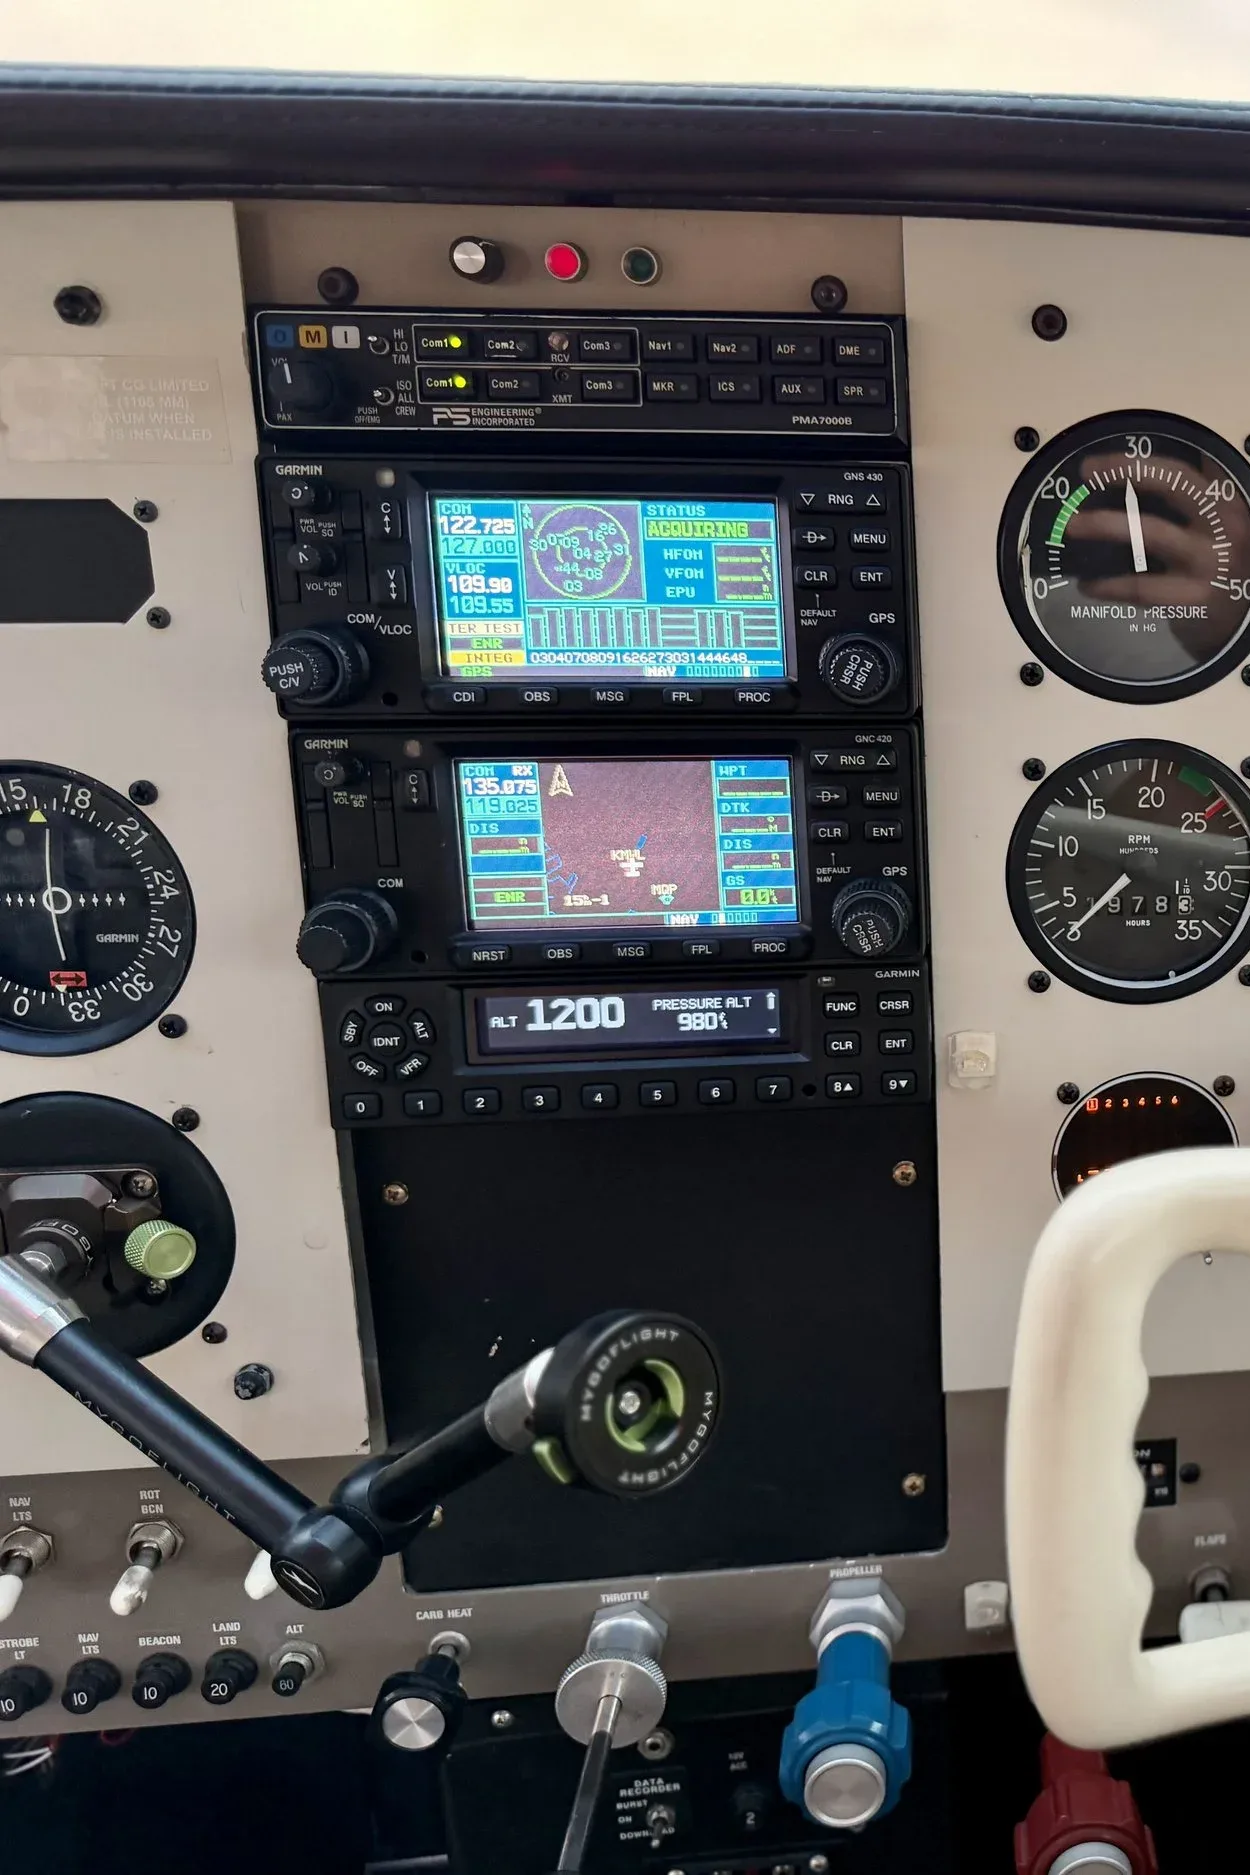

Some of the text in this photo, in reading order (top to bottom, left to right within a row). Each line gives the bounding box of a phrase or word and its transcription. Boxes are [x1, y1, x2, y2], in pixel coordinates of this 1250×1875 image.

[393, 329, 404, 340] HI
[394, 342, 408, 352] LO
[421, 337, 449, 348] Com1
[487, 340, 516, 351] Com2
[583, 340, 611, 351] Com3
[648, 340, 672, 351] Nav1
[713, 342, 737, 353] Nav2
[776, 344, 796, 355] ADF
[839, 346, 860, 357] DME
[396, 381, 412, 391] ISO
[426, 378, 454, 389] Com1
[491, 378, 519, 390] Com2
[652, 382, 675, 392] MKR
[717, 382, 735, 393] ICS
[781, 384, 802, 395] AUX
[843, 386, 864, 397] SPR
[398, 392, 415, 403] ALL
[472, 417, 535, 426] INCORPORATED
[792, 415, 853, 426] PMA7000B
[1125, 436, 1152, 459] 30
[275, 465, 323, 475] GARMIN
[844, 473, 883, 482] GNS 430
[1040, 477, 1070, 499] 20
[1205, 479, 1235, 501] 40
[828, 495, 854, 505] RNG
[441, 504, 472, 516] COM
[647, 505, 706, 517] STATUS
[440, 517, 516, 536] 122.725
[648, 521, 749, 539] ACQUIRING
[853, 534, 886, 544] MENU
[442, 537, 517, 555] 127.000
[664, 548, 703, 561] HFOM
[446, 563, 486, 575] VLOC
[665, 568, 705, 580] VFOM
[804, 571, 828, 582] CLR
[860, 572, 883, 582] ENT
[448, 576, 513, 594] 109.90
[667, 586, 696, 599] EPU
[450, 596, 515, 614] 109.55
[869, 612, 896, 624] GPS
[1071, 606, 1137, 619] MANIFOLD
[450, 623, 521, 635] TER TEST
[472, 637, 503, 650] ENR
[269, 662, 304, 676] PUSH
[279, 677, 300, 689] C/V
[453, 691, 475, 702] CDI
[524, 691, 550, 702] OBS
[596, 691, 624, 702] MSG
[672, 692, 693, 702] FPL
[738, 692, 771, 703] PROC
[304, 739, 348, 749] GARMIN
[840, 756, 865, 765] RNG
[465, 765, 533, 777] COM RX
[464, 778, 537, 795] 135.075
[62, 784, 92, 809] 18
[866, 792, 898, 801] MENU
[1138, 786, 1165, 808] 20
[721, 802, 750, 813] DTK
[1088, 799, 1106, 820] 15
[1180, 812, 1208, 833] 25
[470, 823, 499, 834] DIS
[818, 828, 842, 838] CLR
[872, 828, 895, 837] ENT
[1128, 835, 1151, 845] RPM
[1058, 836, 1079, 857] 10
[154, 869, 180, 899] 24
[378, 878, 404, 888] COM
[727, 875, 745, 886] GS
[1126, 919, 1151, 927] HOURS
[1175, 920, 1202, 941] 35
[96, 933, 140, 943] GARMIN
[547, 948, 573, 959] OBS
[617, 946, 645, 957] MSG
[692, 944, 712, 955] FPL
[754, 942, 786, 954] PROC
[473, 949, 506, 961] NRST
[875, 970, 920, 979] GARMIN
[375, 1002, 393, 1012] ON
[652, 996, 752, 1011] PRESSURE ALT
[826, 1001, 856, 1012] FUNC
[880, 1000, 910, 1010] CRSR
[490, 997, 626, 1031] ALT 1200
[413, 1020, 430, 1040] ALT
[373, 1036, 400, 1047] IDNT
[831, 1041, 853, 1051] CLR
[885, 1039, 907, 1049] ENT
[355, 1060, 379, 1078] OFF
[400, 1057, 422, 1077] VFR
[580, 1328, 680, 1421] MYGOFLIGHT
[617, 1391, 714, 1484] MYGOFLIGHT
[139, 1490, 160, 1500] ROT
[9, 1497, 31, 1507] NAV
[141, 1504, 164, 1515] BCN
[12, 1511, 32, 1521] LTS
[830, 1565, 882, 1578] PROPELLER
[600, 1591, 650, 1603] THROTTLE
[416, 1607, 473, 1620] CARB HEAT
[212, 1622, 241, 1632] LAND
[286, 1624, 304, 1634] ALT
[138, 1635, 181, 1646] BEACON
[210, 1683, 228, 1697] 20
[634, 1777, 664, 1788] DATA
[619, 1782, 681, 1798] RECORDER
